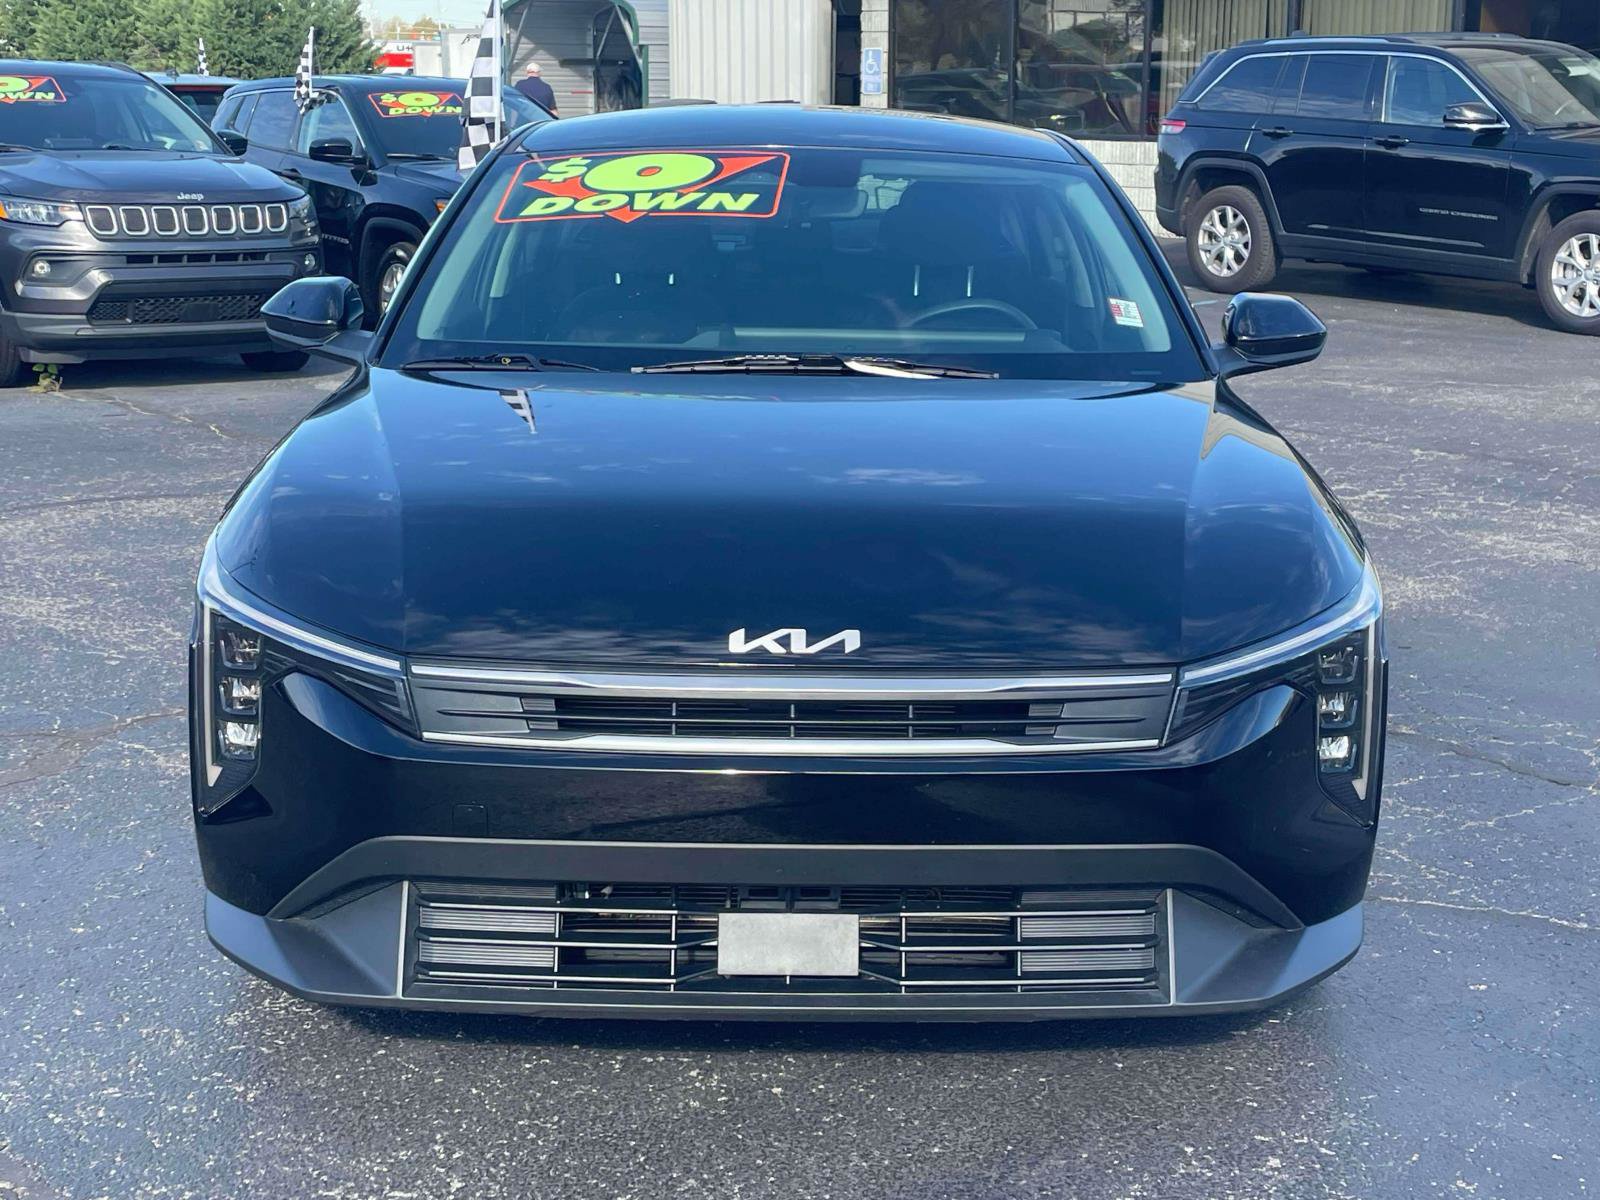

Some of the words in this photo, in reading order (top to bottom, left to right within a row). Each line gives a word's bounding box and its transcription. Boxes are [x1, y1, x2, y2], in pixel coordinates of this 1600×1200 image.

[0, 91, 55, 100] WN
[388, 106, 463, 115] DOWN
[176, 191, 204, 201] Jeep
[519, 192, 760, 216] DOWN
[728, 627, 861, 654] KIA
